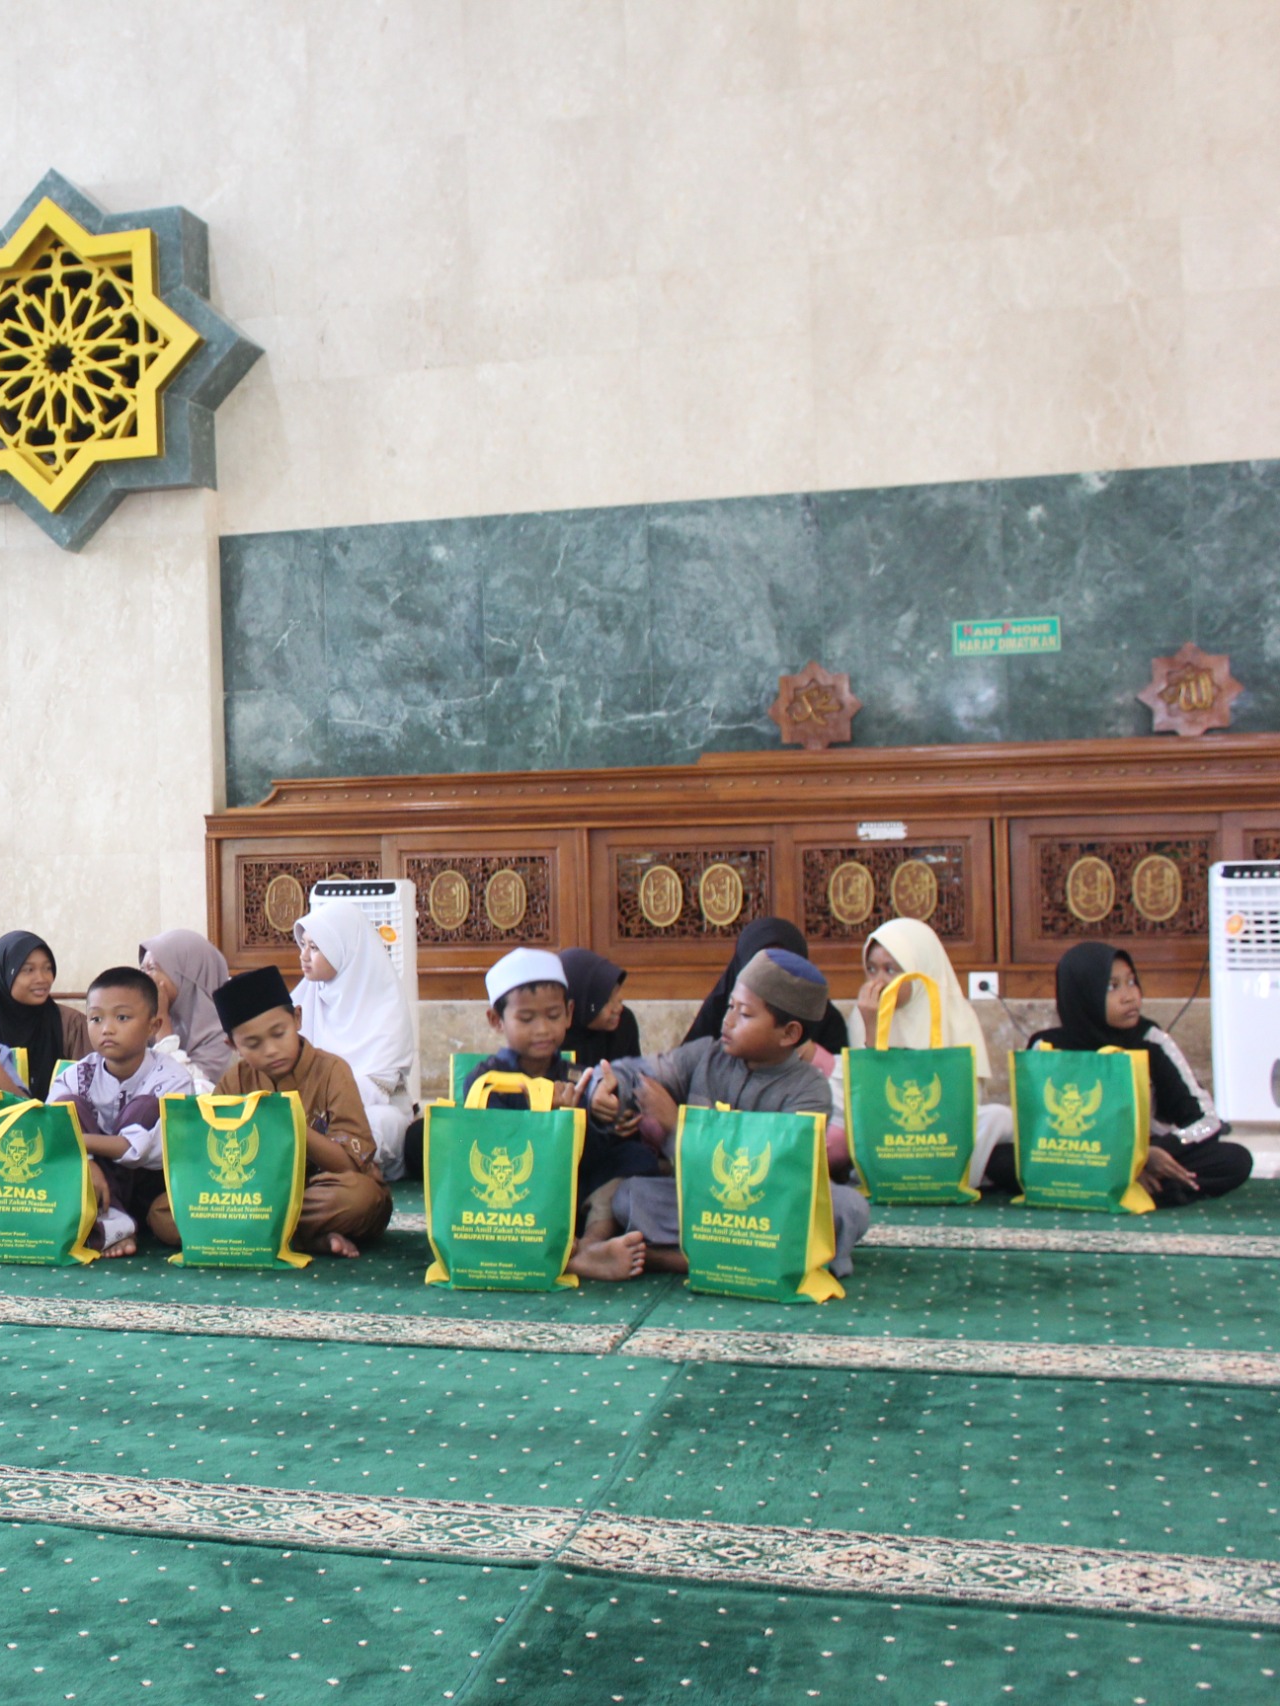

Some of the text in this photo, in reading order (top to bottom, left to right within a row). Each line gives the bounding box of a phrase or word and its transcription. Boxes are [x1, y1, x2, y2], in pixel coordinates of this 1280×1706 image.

[884, 1132, 948, 1146] BAZNAS
[1037, 1137, 1101, 1153] BAZNAS
[198, 1192, 262, 1205] BAZNAS
[462, 1211, 536, 1227] BAZNAS
[701, 1210, 771, 1231] BAZNAS
[453, 1232, 544, 1243] KABUPATEN KUTAI TIMUR
[693, 1232, 777, 1249] KABUPATEN KUTAI TIMUR
